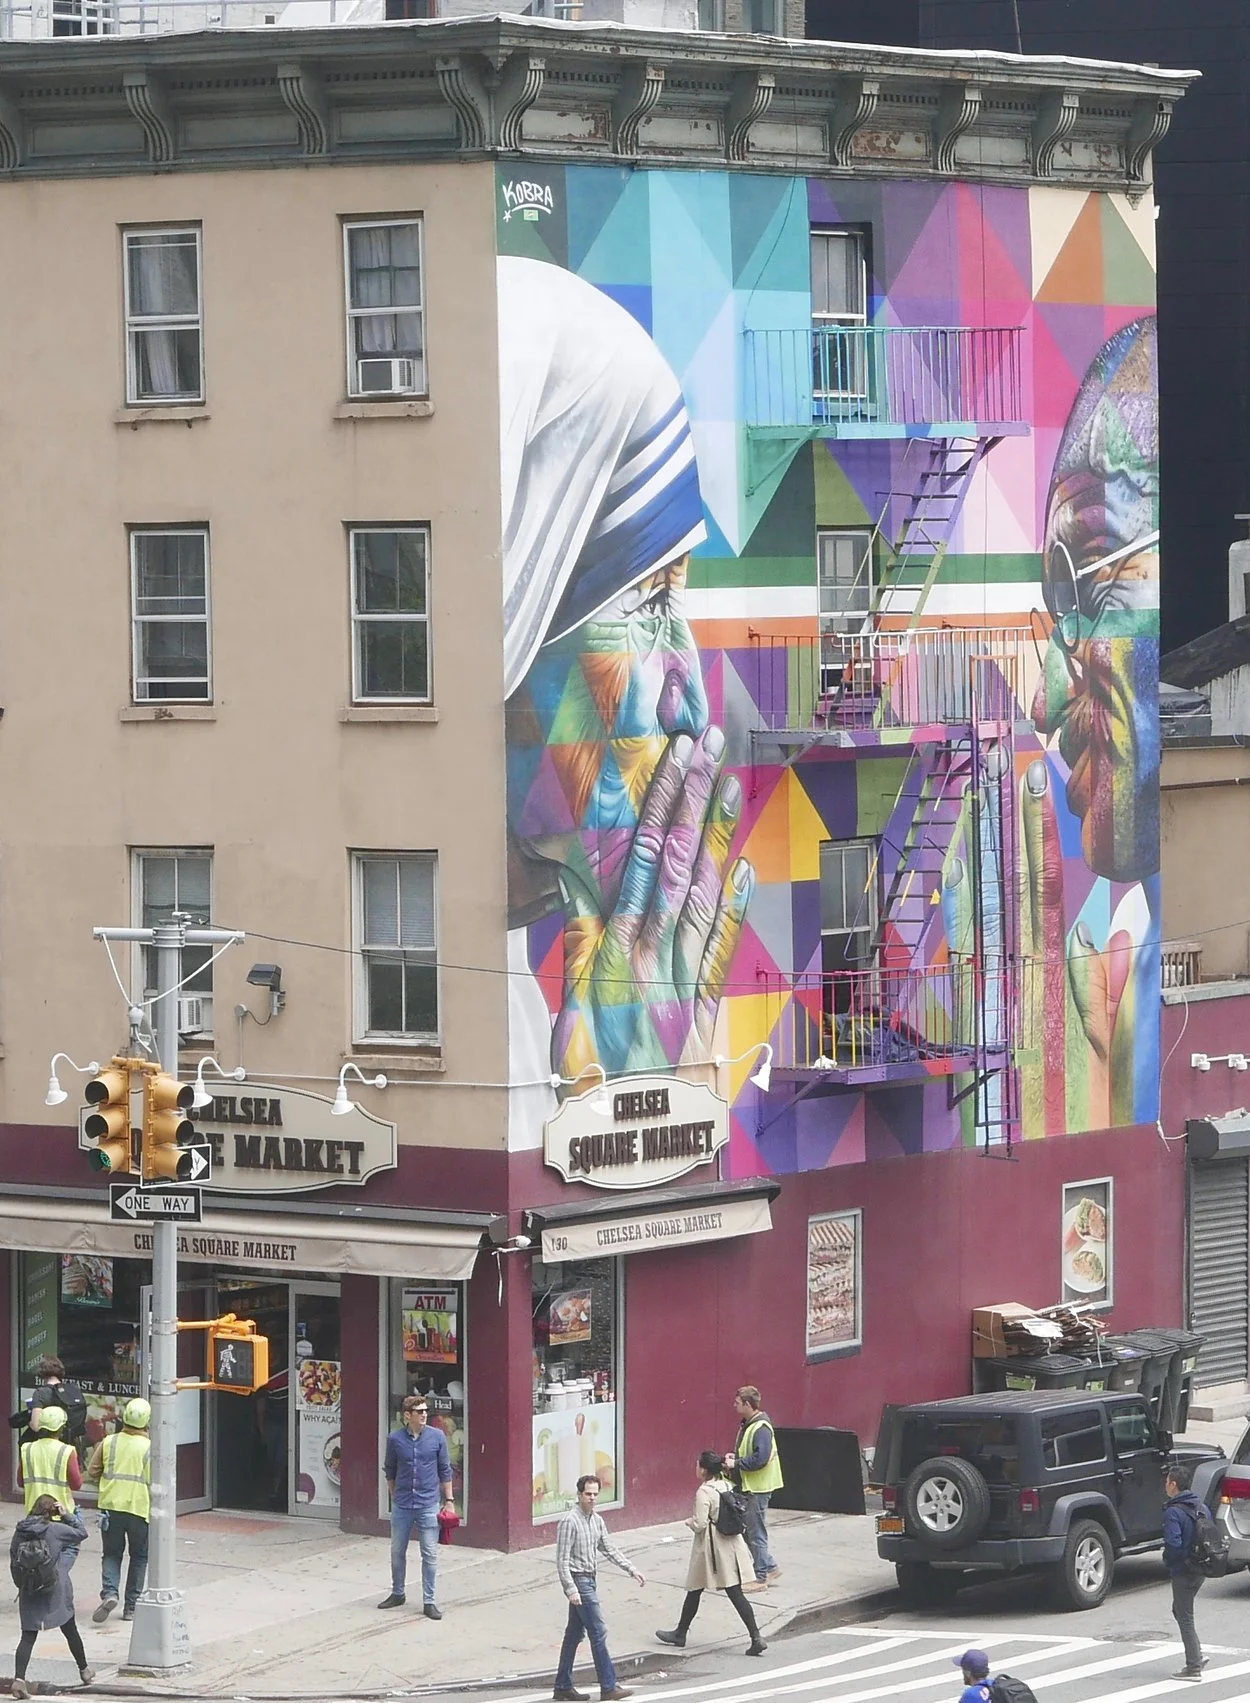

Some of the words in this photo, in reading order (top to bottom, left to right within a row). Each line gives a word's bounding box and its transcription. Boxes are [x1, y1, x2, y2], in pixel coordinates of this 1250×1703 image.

[502, 180, 554, 207] KOBRA
[614, 1088, 671, 1121] CHELSEA
[234, 1134, 365, 1175] MARKET
[569, 1130, 638, 1174] SQUARE
[642, 1120, 715, 1161] MARKET
[125, 1196, 151, 1211] ONE
[162, 1197, 190, 1212] WAY
[597, 1224, 641, 1246] CHELSEA
[645, 1218, 682, 1240] SQUARE
[685, 1212, 722, 1231] MARKET
[193, 1237, 239, 1257] SQUARE
[243, 1241, 297, 1261] MARKET
[551, 1236, 568, 1251] 130
[415, 1295, 446, 1311] ATM
[97, 1382, 104, 1392] &
[304, 1413, 320, 1422] WHY
